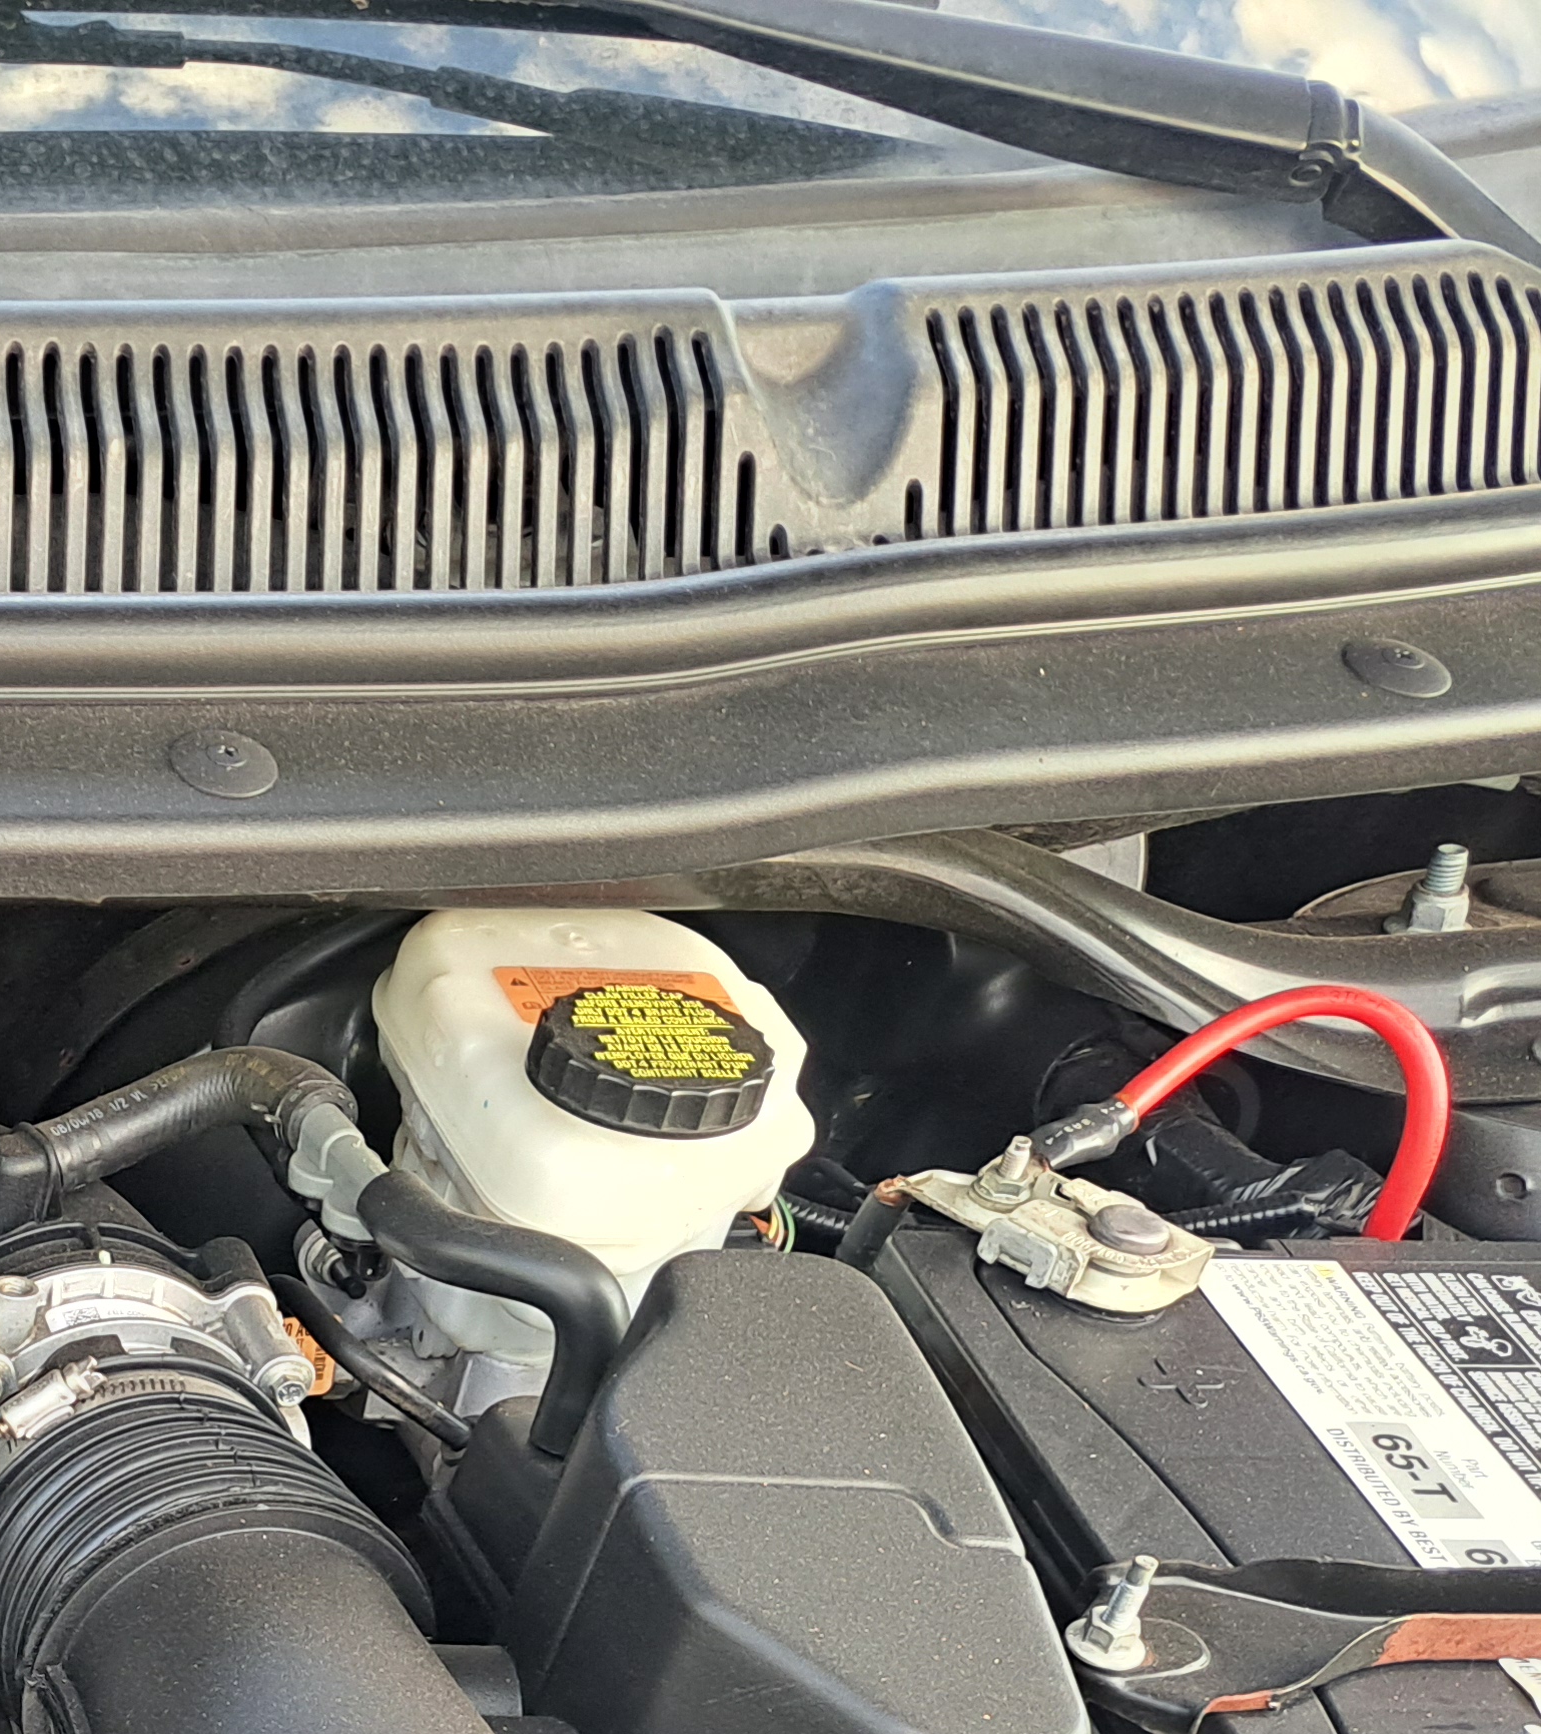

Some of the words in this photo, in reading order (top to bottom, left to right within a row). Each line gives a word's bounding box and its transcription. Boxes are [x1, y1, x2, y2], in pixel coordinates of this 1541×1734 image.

[1322, 1276, 1368, 1318] WARNING
[1323, 1427, 1405, 1506] DISTRIBUTED
[1364, 1433, 1459, 1502] 65-T
[1431, 1450, 1477, 1488] Number
[1458, 1458, 1491, 1478] Part
[1389, 1509, 1422, 1526] BY
[1405, 1530, 1451, 1562] BEST
